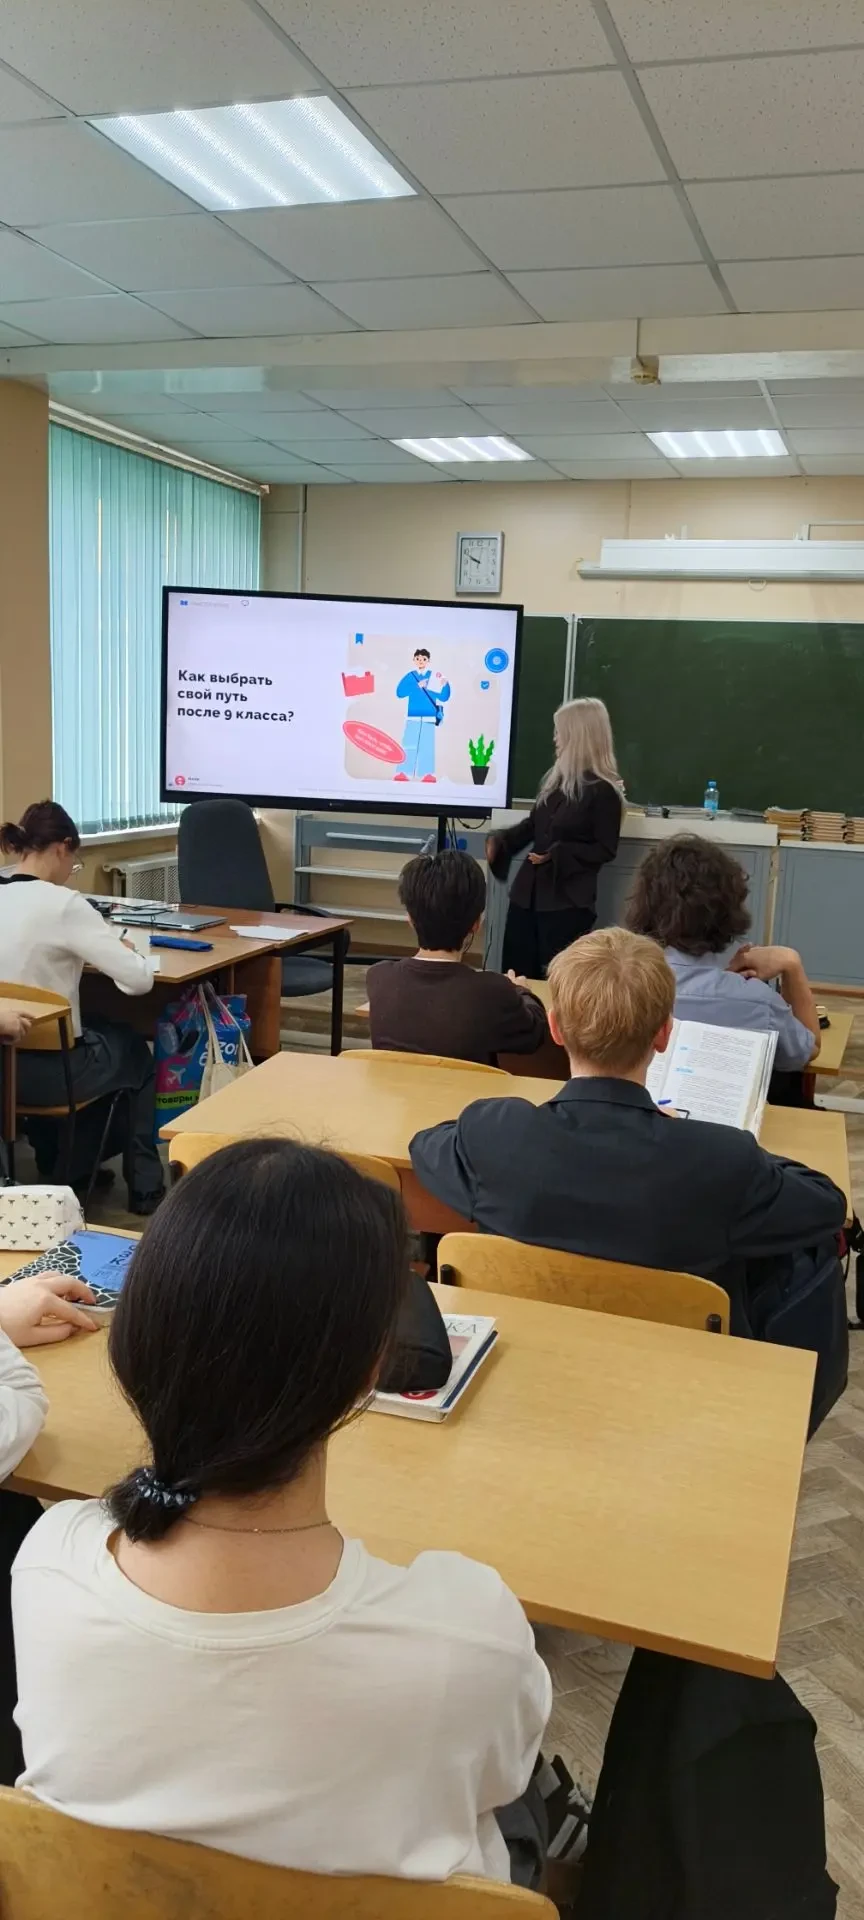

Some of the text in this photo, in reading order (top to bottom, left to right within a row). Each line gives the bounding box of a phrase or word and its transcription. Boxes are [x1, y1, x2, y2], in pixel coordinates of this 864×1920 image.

[178, 669, 273, 687] Как выбрать
[177, 689, 248, 704] свой путь
[177, 707, 294, 722] после 9 класса?
